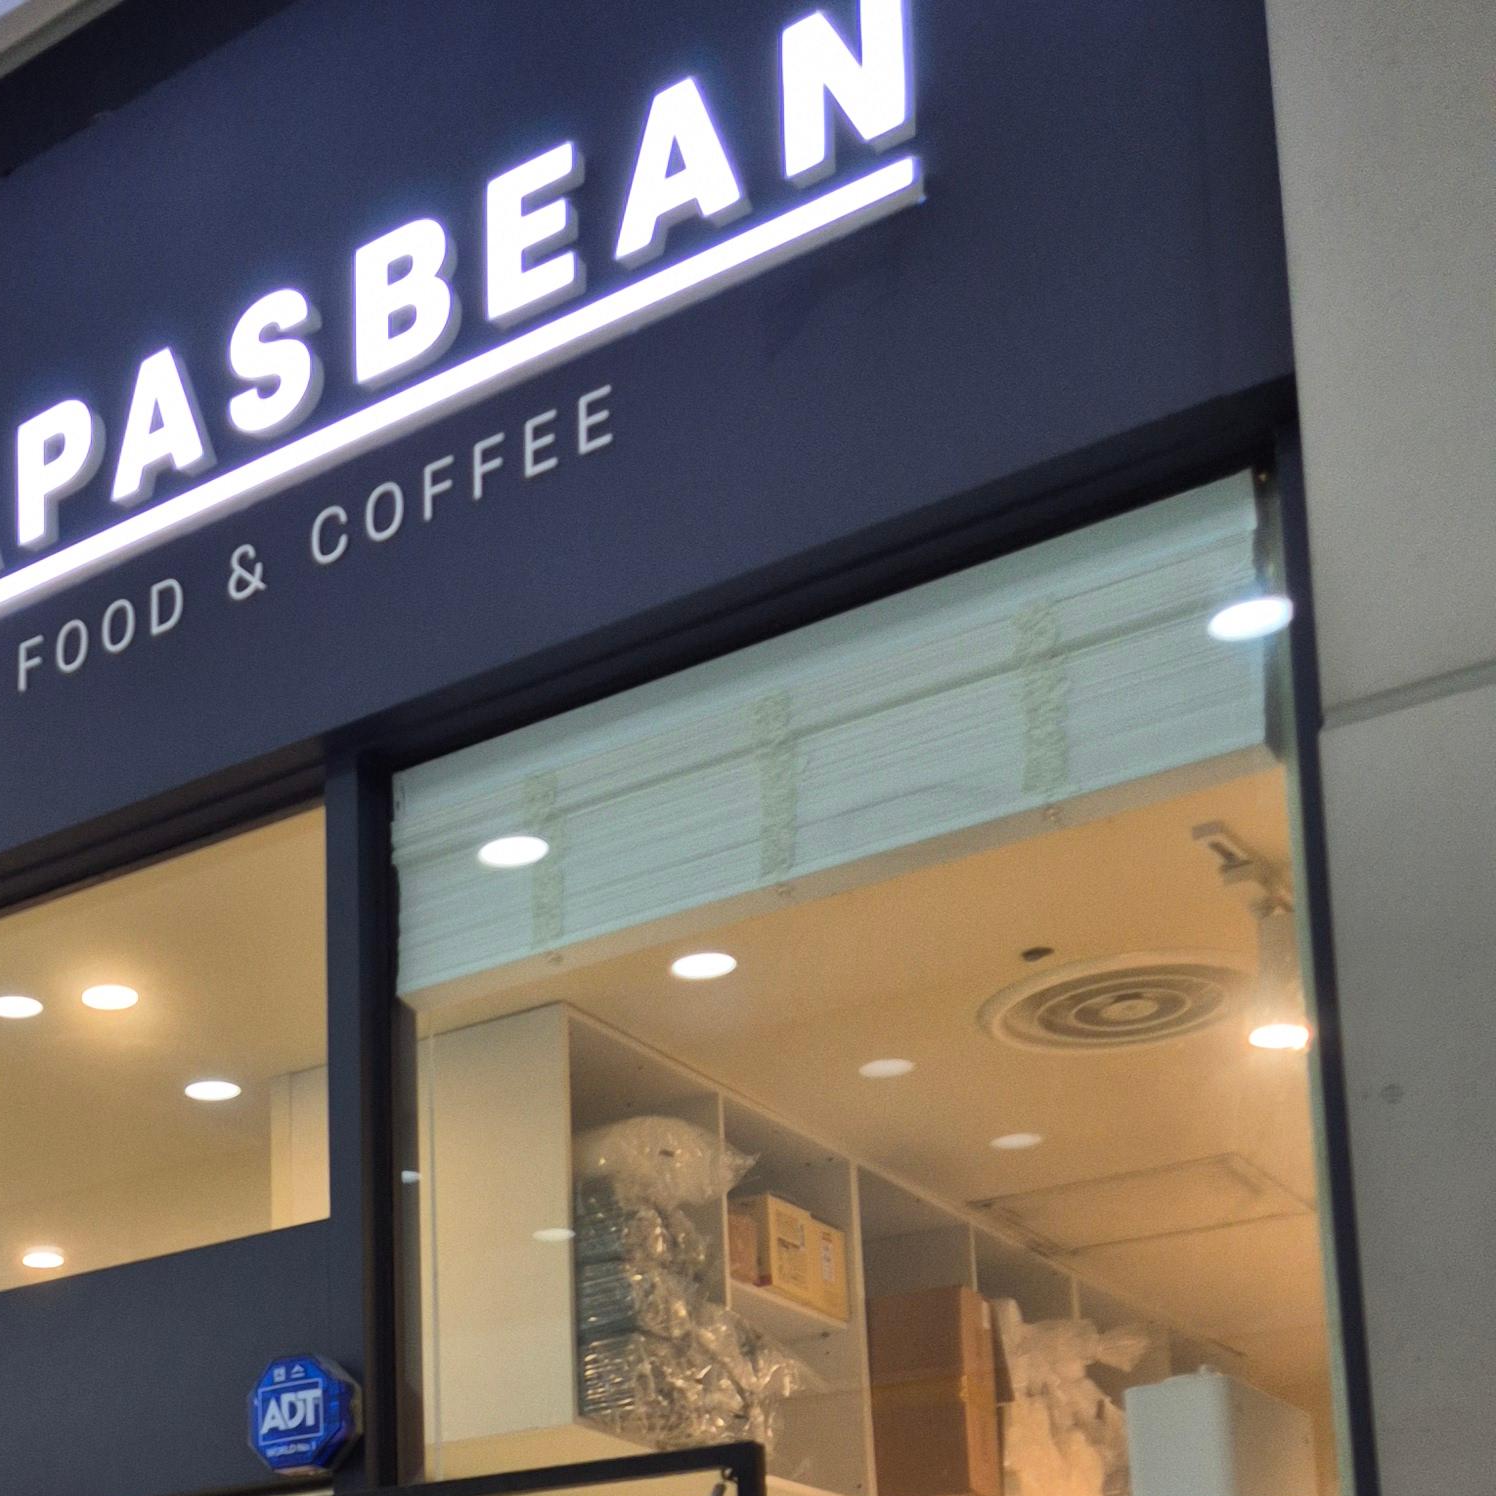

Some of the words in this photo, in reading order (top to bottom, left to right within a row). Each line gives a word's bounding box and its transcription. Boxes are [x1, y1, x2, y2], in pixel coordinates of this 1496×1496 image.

[18, 579, 184, 692] FOOD
[228, 544, 266, 600] &
[311, 385, 612, 565] COFFEE
[261, 1388, 322, 1434] ADT
